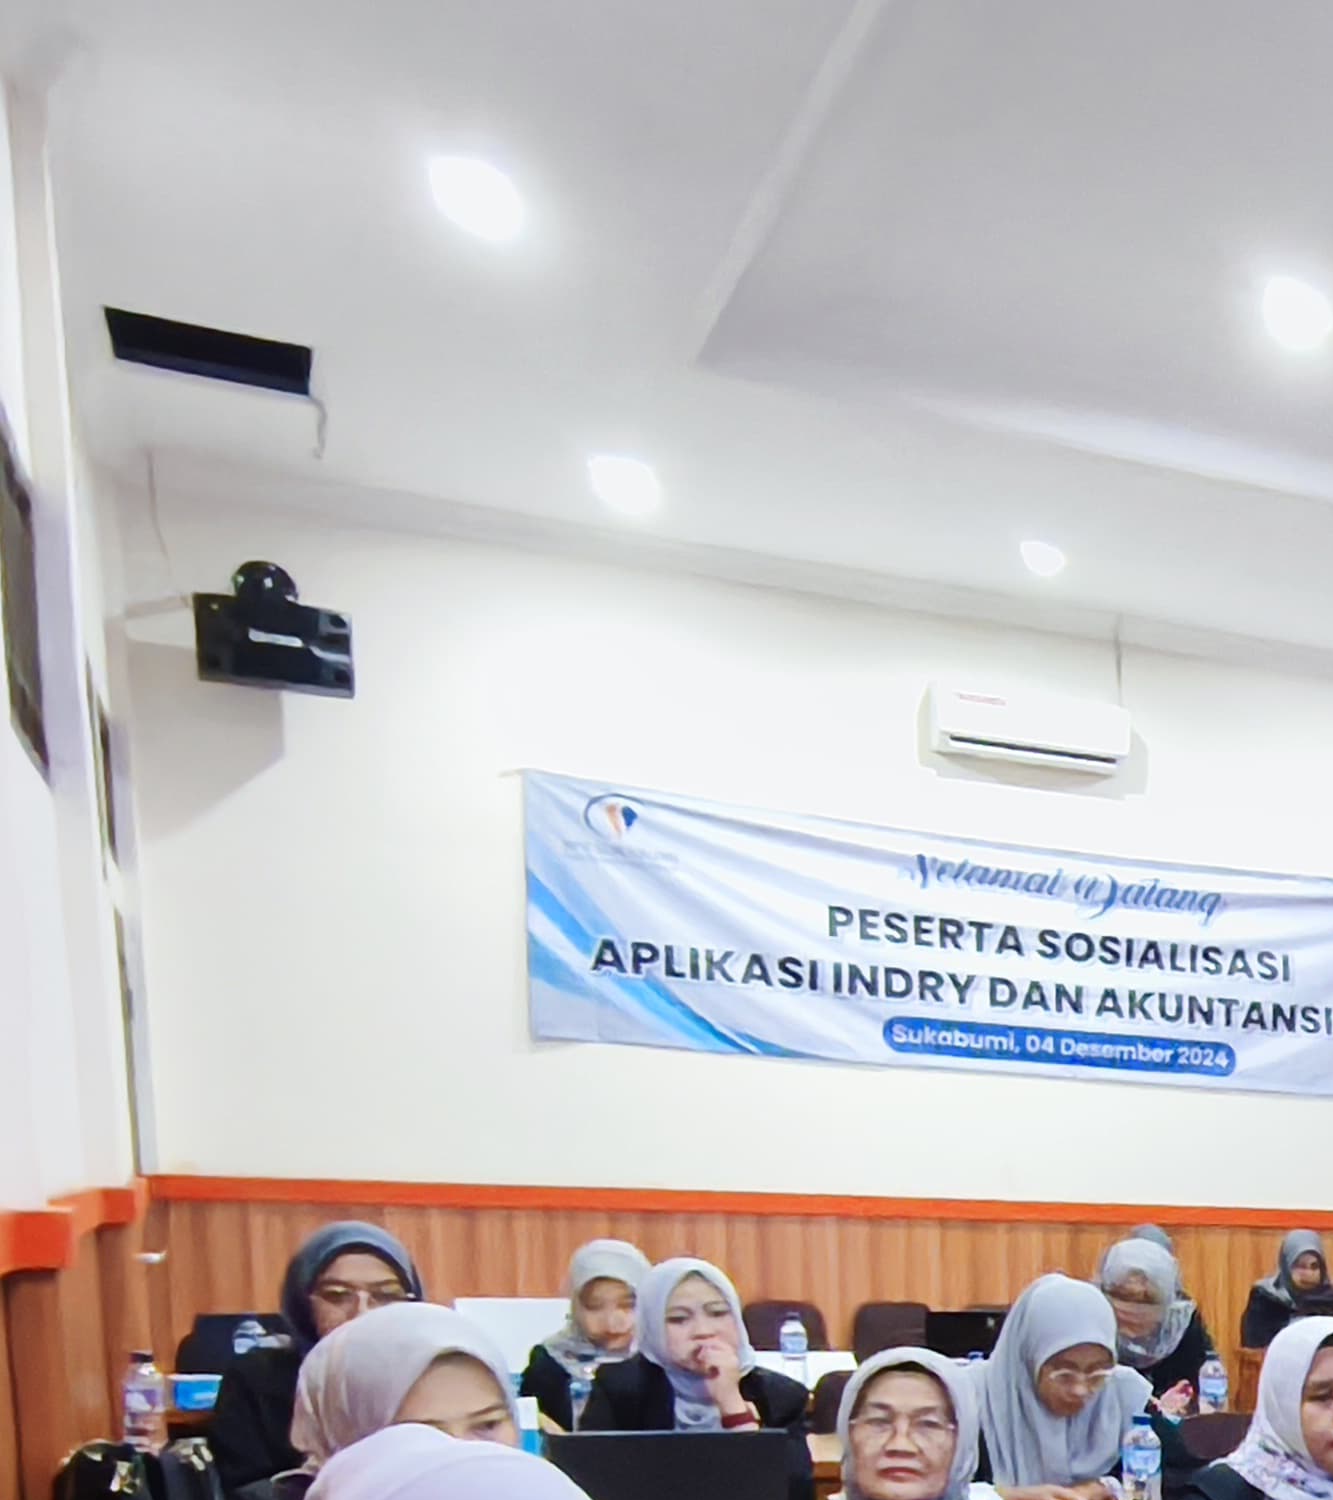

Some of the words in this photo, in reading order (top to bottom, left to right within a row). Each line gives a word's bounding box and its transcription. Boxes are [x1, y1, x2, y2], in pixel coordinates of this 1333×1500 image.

[828, 905, 1026, 958] PESERTA
[1035, 928, 1291, 983] SOSIALISASI
[589, 938, 819, 992] APLIKASI
[833, 963, 976, 1005] INDRY
[988, 976, 1084, 1015] DAN
[1094, 986, 1333, 1036] AKUNTANSI
[890, 1022, 1021, 1053] Sukabumi,
[1025, 1033, 1055, 1052] 04
[1060, 1039, 1175, 1064] Desember
[1178, 1047, 1231, 1069] 2024
